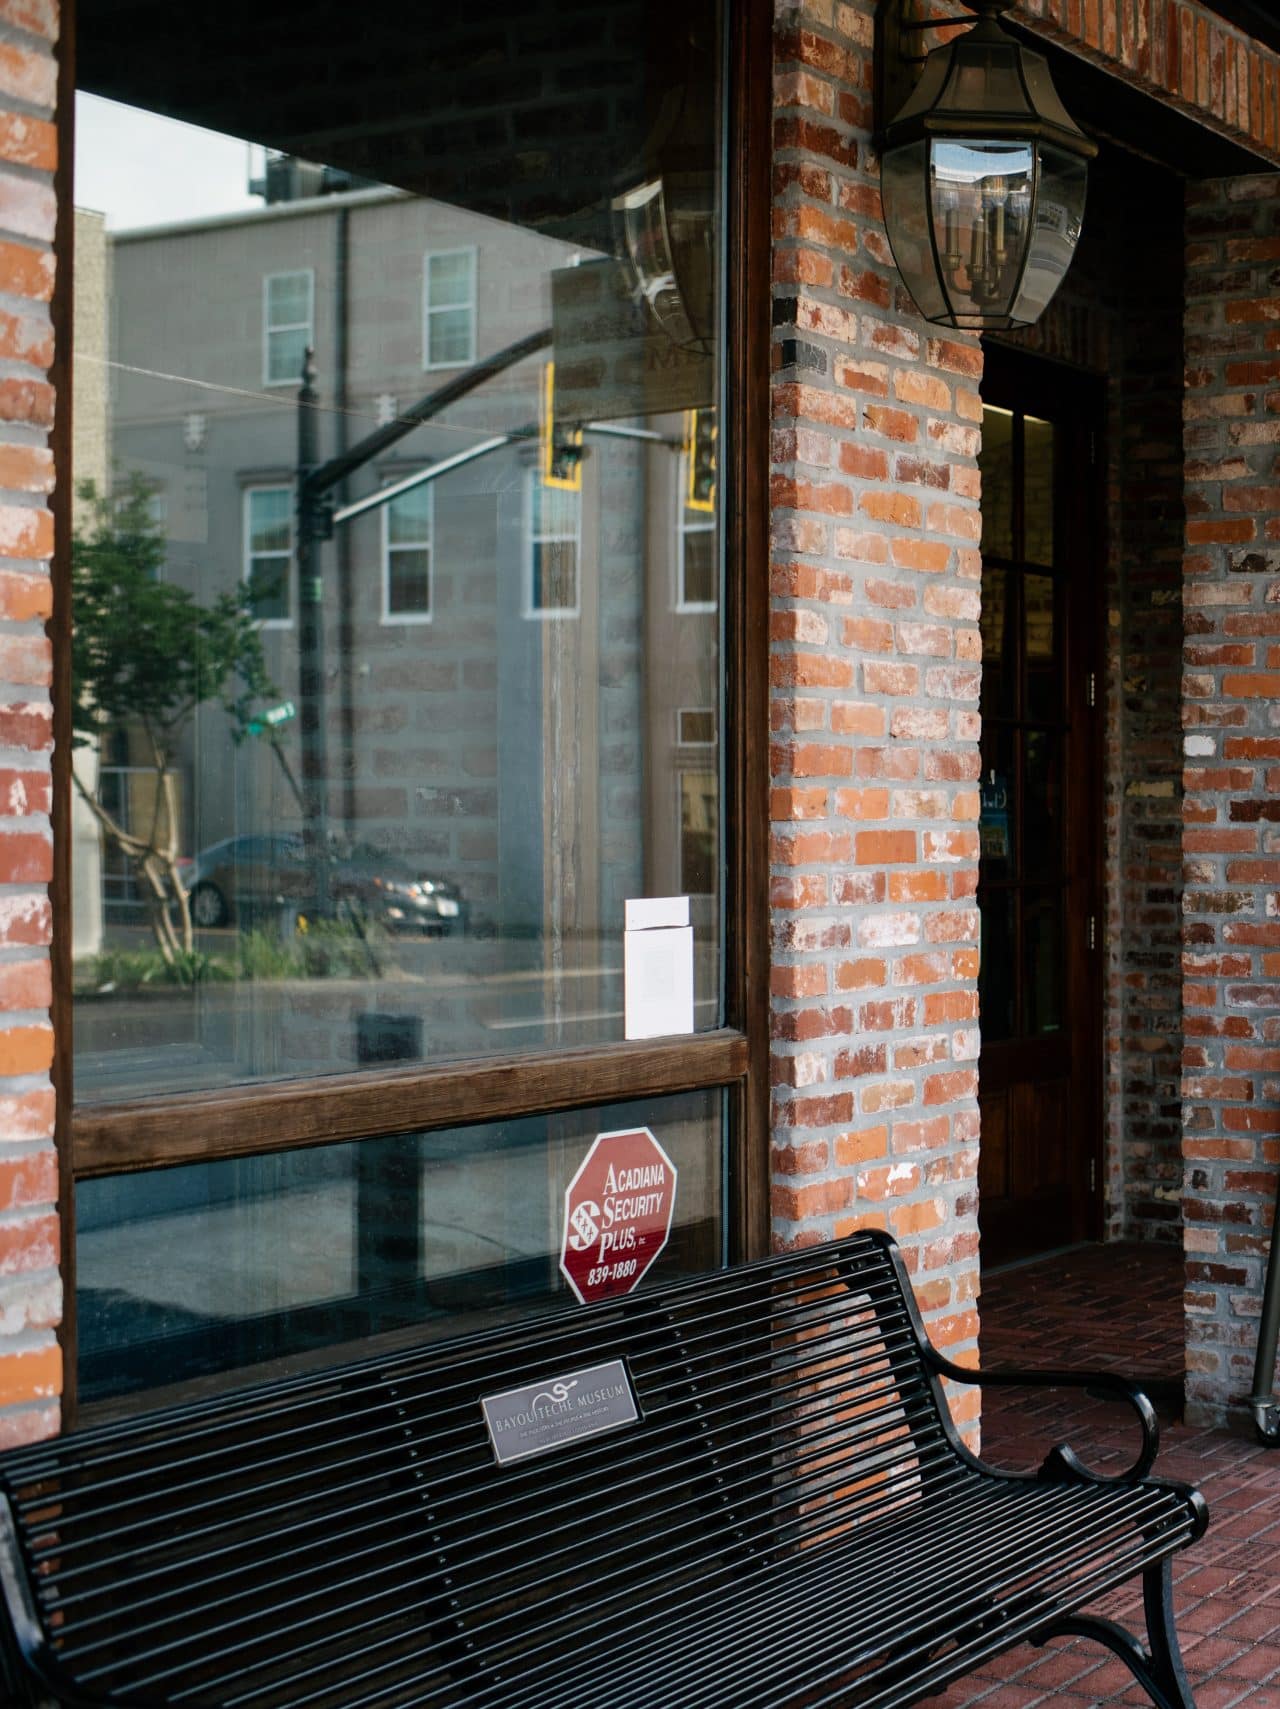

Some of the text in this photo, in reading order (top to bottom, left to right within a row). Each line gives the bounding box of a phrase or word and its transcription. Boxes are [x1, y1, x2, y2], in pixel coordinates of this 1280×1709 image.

[602, 1162, 665, 1196] ACADIANA
[601, 1192, 664, 1230] SECURITY
[587, 1258, 637, 1287] 839-1880
[496, 1413, 535, 1433] BAYOU
[537, 1399, 574, 1421] TECHE
[577, 1384, 625, 1407] MUSEUM
